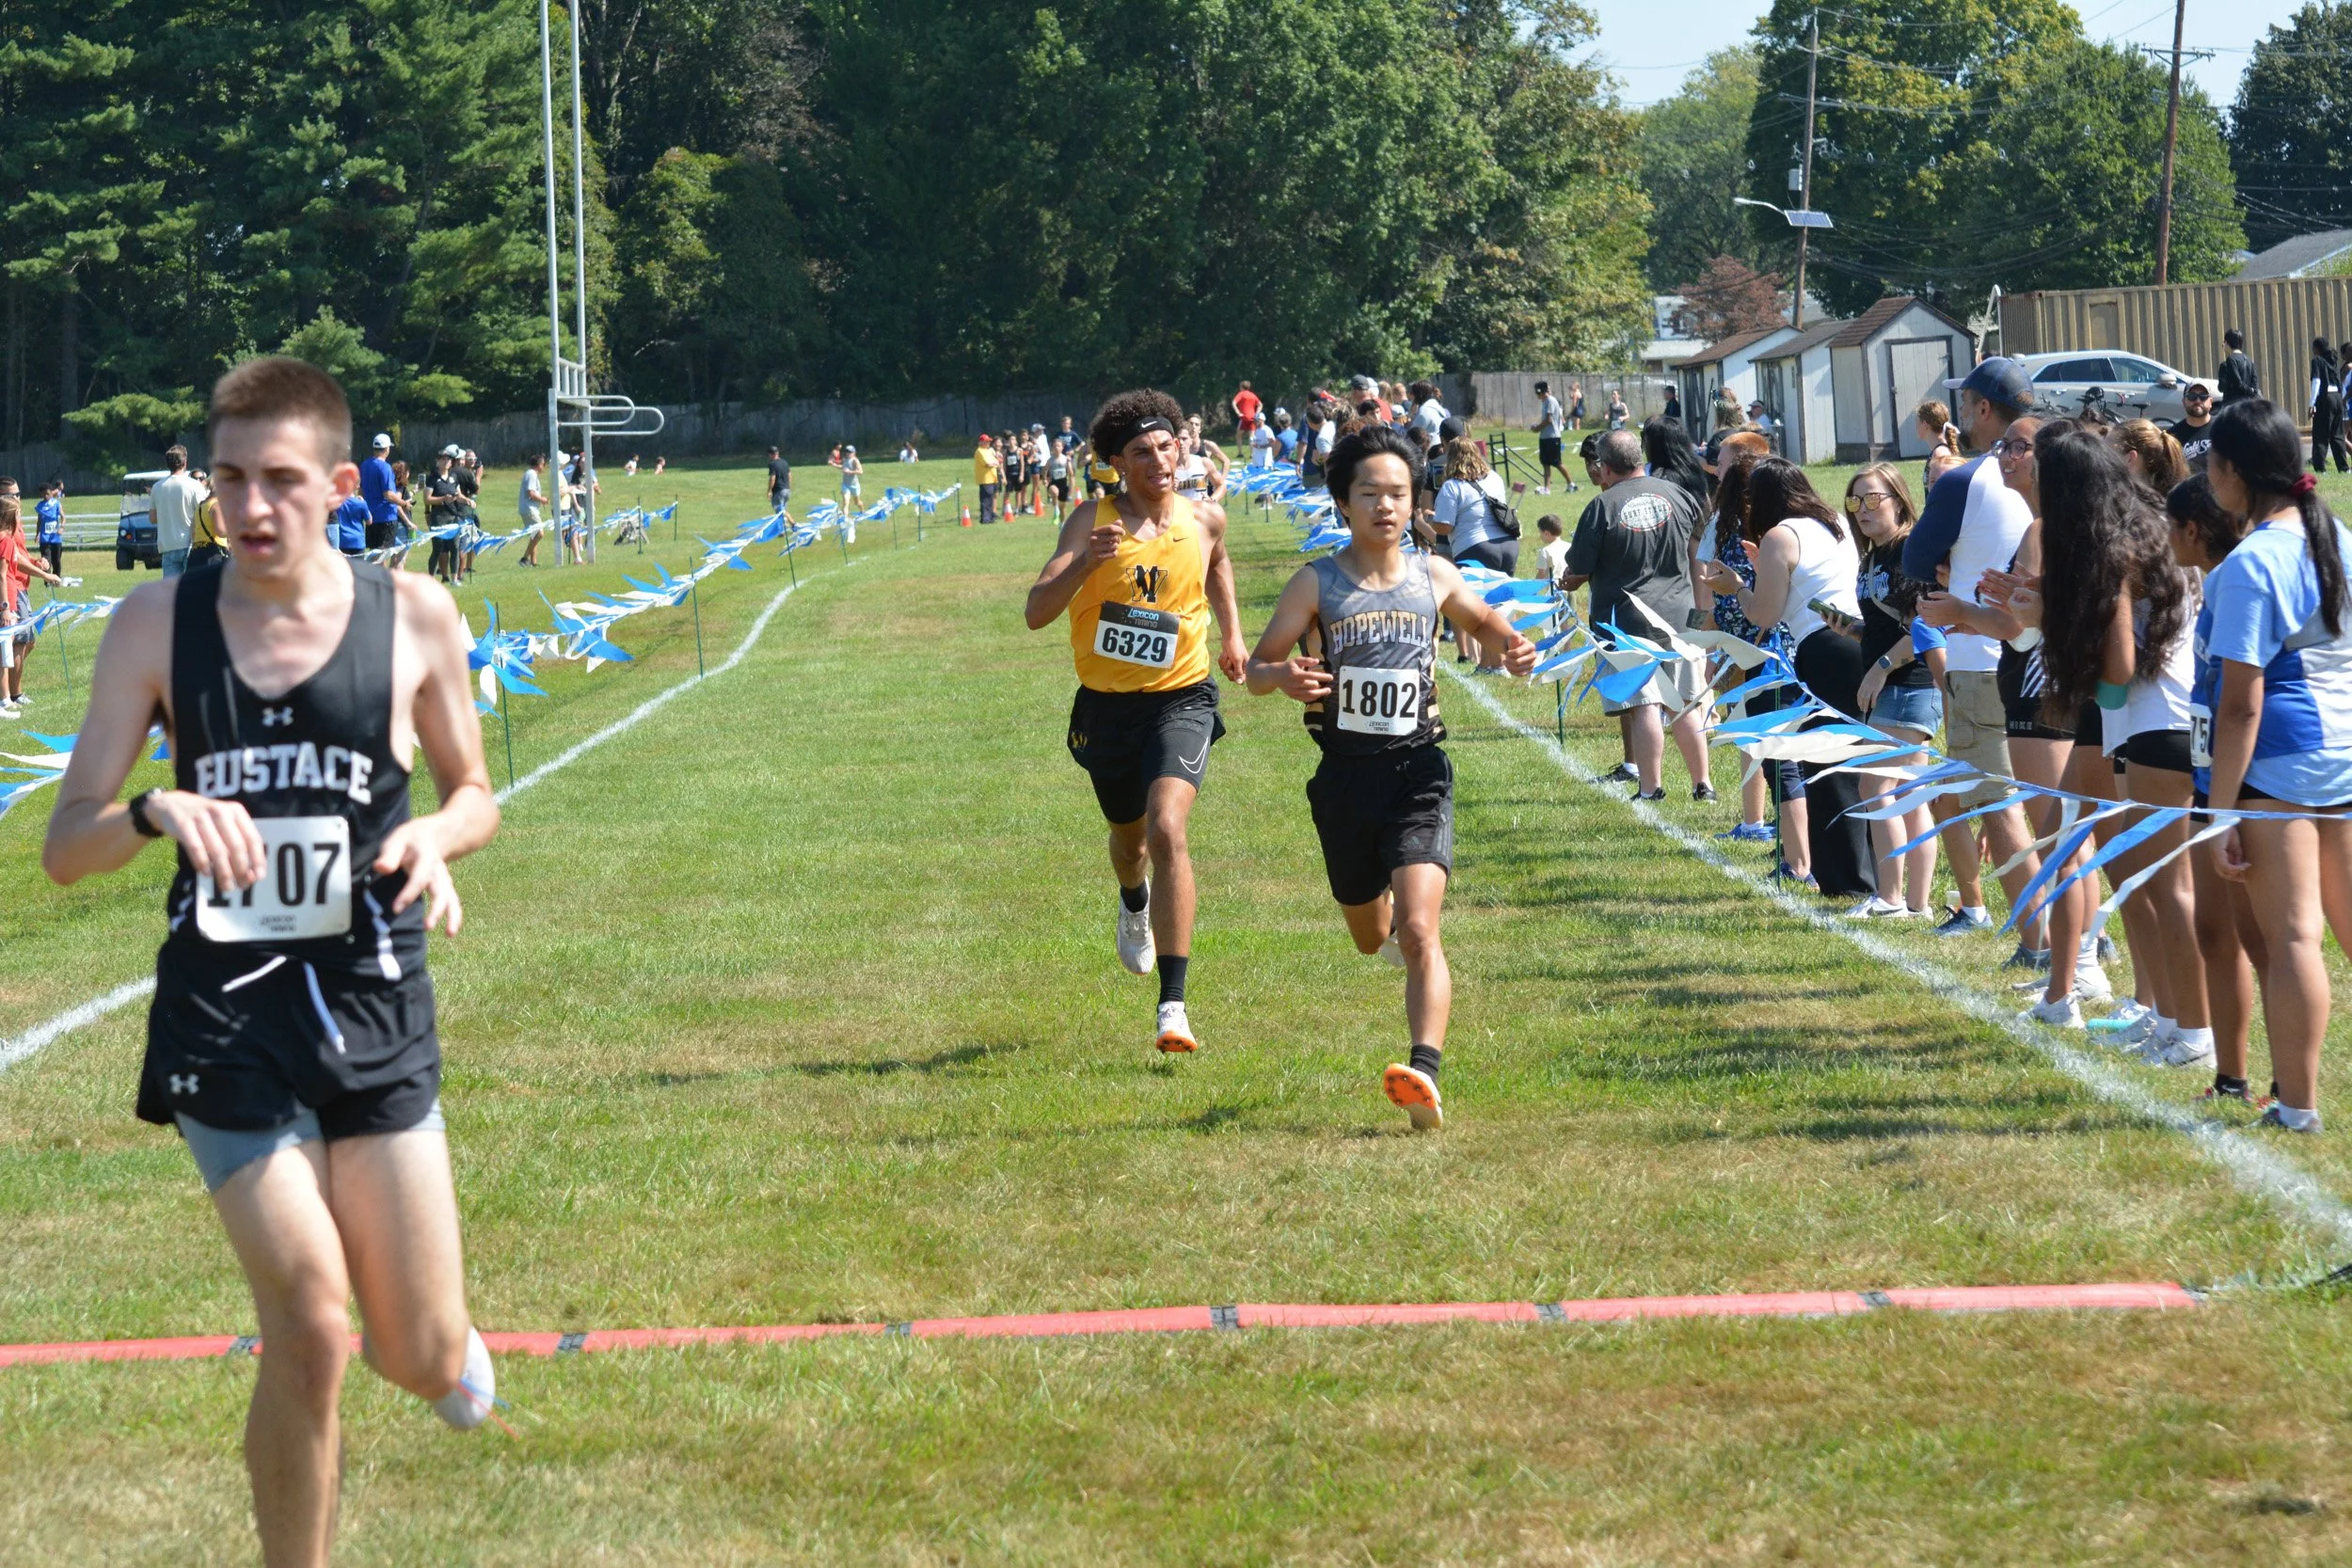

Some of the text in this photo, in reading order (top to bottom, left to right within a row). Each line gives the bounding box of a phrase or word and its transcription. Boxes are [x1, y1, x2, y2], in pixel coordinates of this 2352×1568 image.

[1102, 626, 1168, 663] 6329
[1329, 610, 1430, 655] HOPEWELL
[1342, 678, 1417, 719] 1802
[194, 740, 373, 805] EUSTACE
